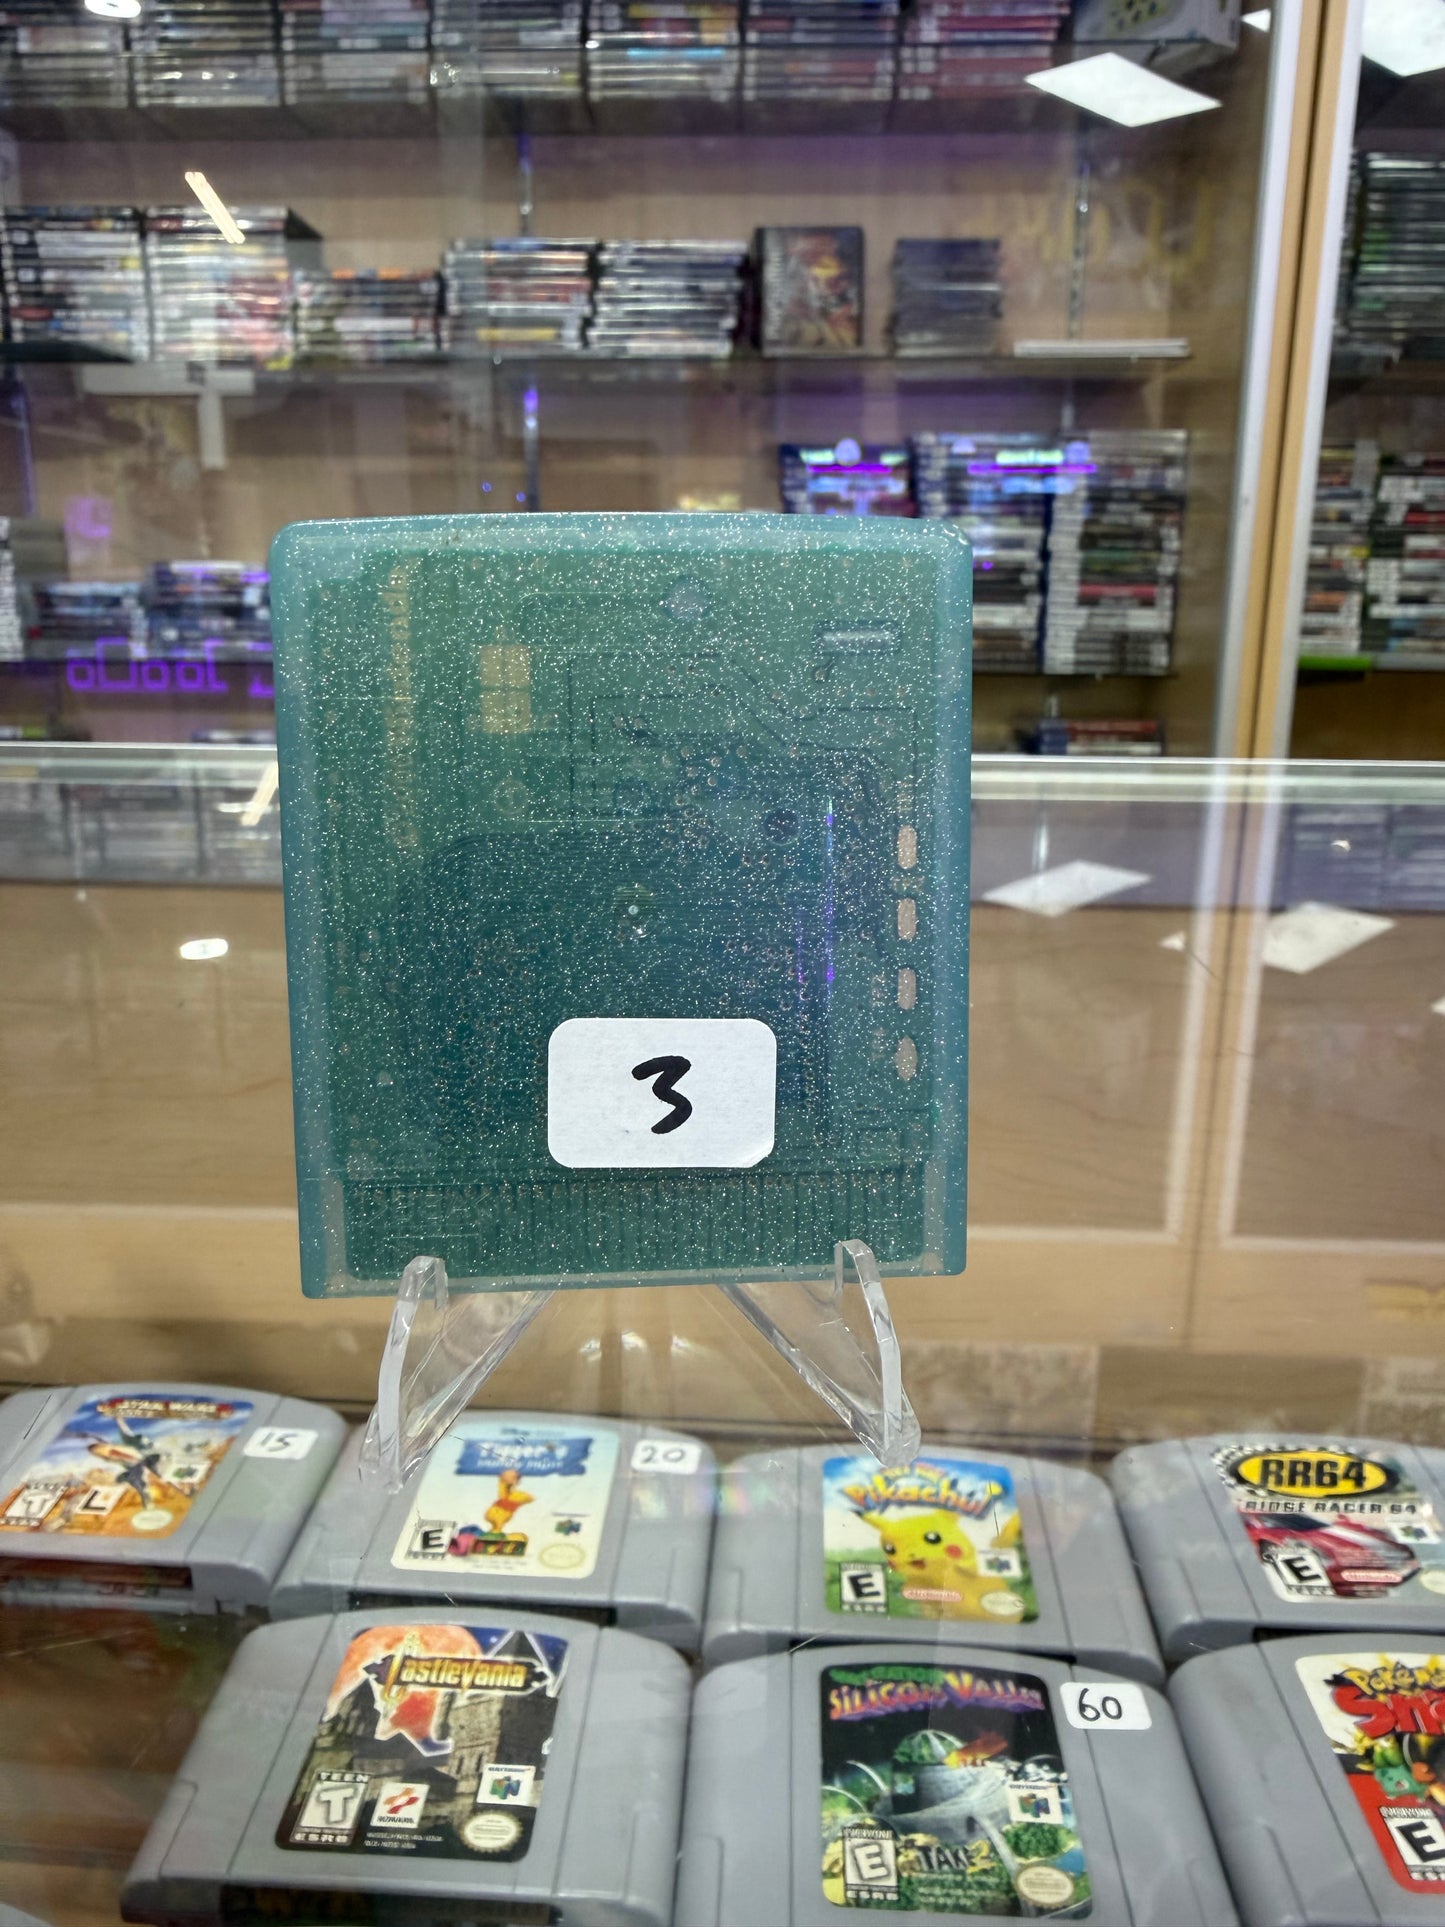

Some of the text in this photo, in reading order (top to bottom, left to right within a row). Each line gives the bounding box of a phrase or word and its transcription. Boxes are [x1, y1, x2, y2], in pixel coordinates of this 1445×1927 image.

[631, 1055, 693, 1135] 3
[260, 1431, 299, 1452] 15
[641, 1444, 687, 1464] 20
[1260, 1458, 1367, 1489] RR64
[1314, 1501, 1382, 1514] RACER
[1390, 1503, 1417, 1515] 64
[422, 1528, 446, 1550] E
[1283, 1556, 1323, 1583] E
[848, 1572, 882, 1600] E
[1078, 1687, 1123, 1722] 60
[319, 1771, 371, 1784] TEEN
[319, 1787, 355, 1823] T
[1395, 1820, 1445, 1863] E
[854, 1844, 889, 1880] E
